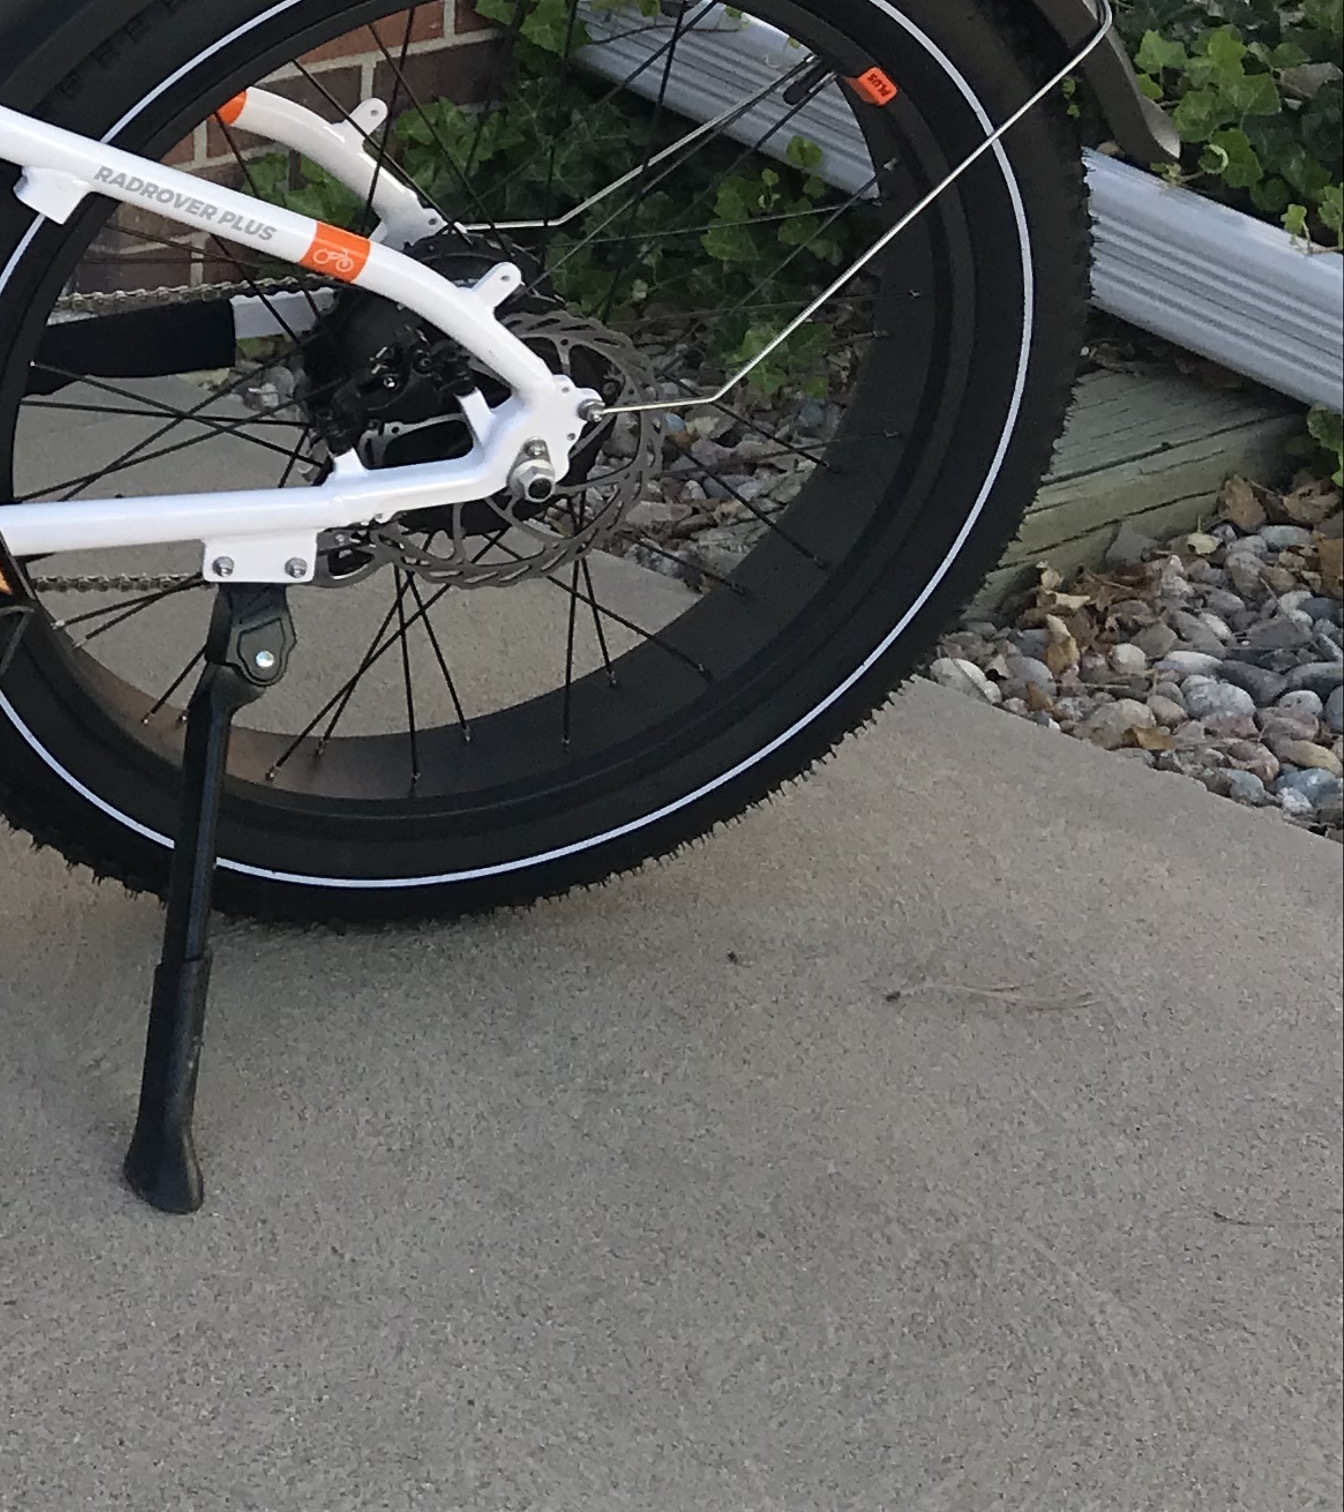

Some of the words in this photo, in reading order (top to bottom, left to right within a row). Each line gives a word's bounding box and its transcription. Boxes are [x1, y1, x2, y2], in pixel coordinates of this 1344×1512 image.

[866, 72, 892, 97] PLUS
[94, 166, 218, 221] RADROVER
[217, 210, 277, 241] PLUS
